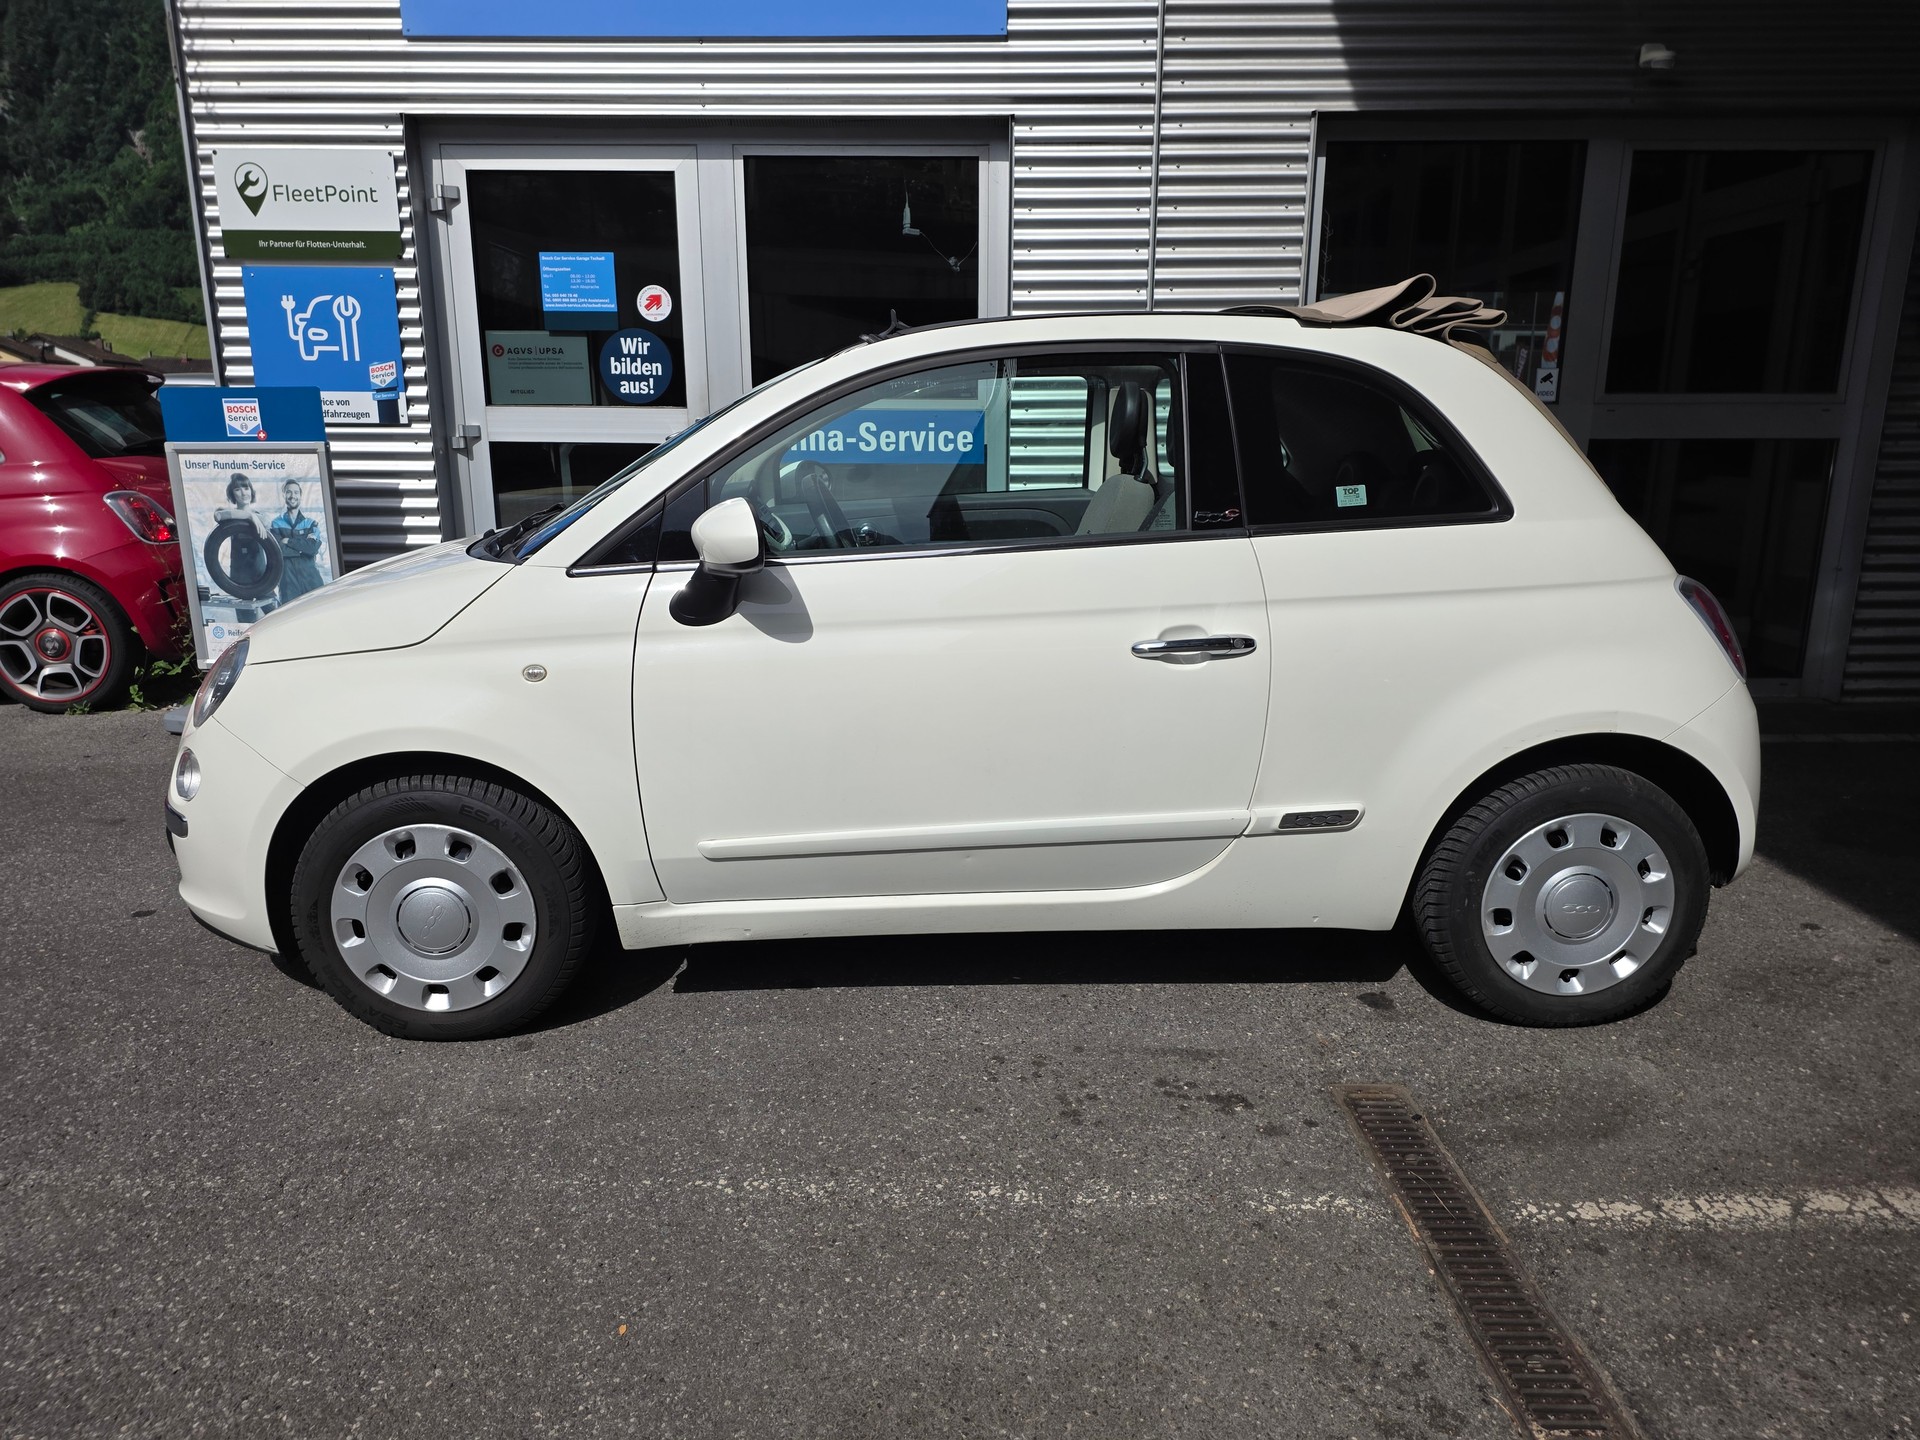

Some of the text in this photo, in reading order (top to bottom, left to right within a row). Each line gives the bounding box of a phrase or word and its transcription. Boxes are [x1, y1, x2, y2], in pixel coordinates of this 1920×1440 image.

[272, 184, 378, 203] FleetPoint
[258, 240, 367, 249] Ihr Partner für Flotten-Unterhalt.
[507, 347, 564, 355] AGVS UPSA
[620, 337, 650, 355] Wir
[370, 363, 394, 374] BOSCH
[610, 357, 662, 376] bilden
[371, 371, 395, 380] Service
[620, 378, 655, 394] aus!
[185, 460, 286, 470] Unser Rundum-Service
[1343, 487, 1359, 495] TOP
